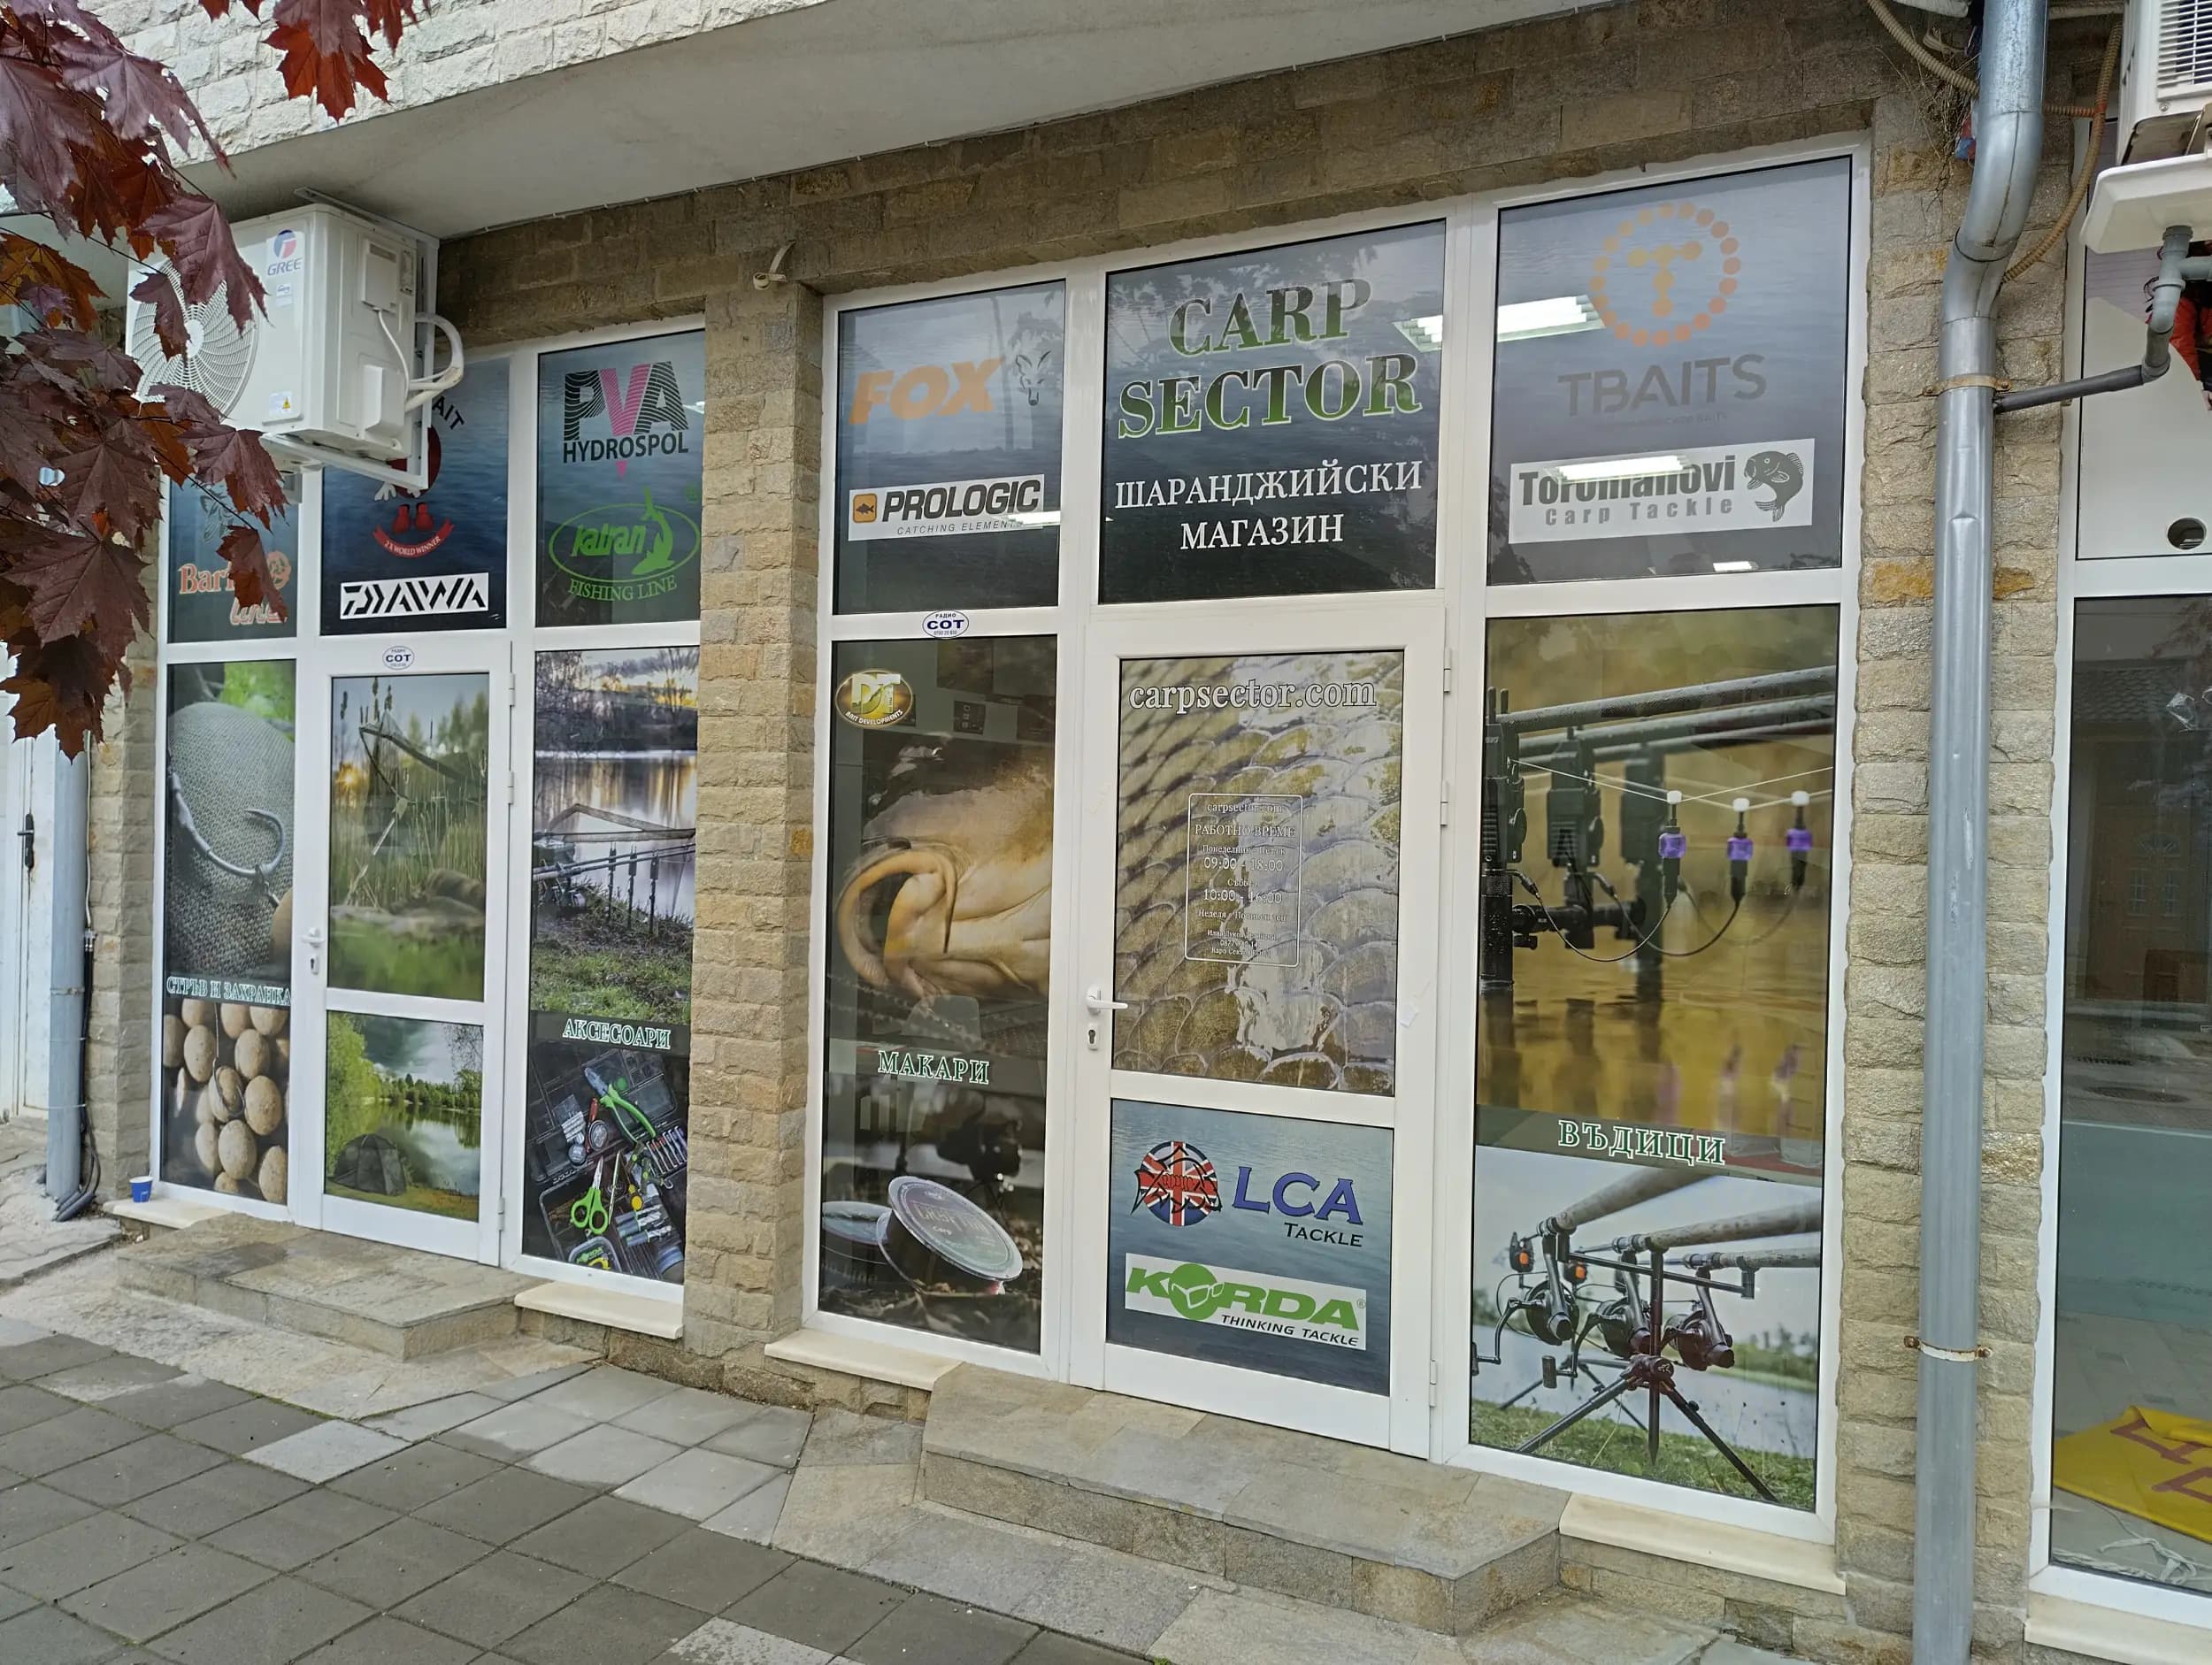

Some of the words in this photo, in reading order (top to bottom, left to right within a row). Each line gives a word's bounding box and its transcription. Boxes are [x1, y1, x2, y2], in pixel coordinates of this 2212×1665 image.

[267, 257, 303, 277] GREE
[1169, 278, 1371, 357] CARP
[564, 361, 689, 441] PVA
[849, 357, 1004, 425] FOX
[1118, 353, 1422, 439] SECTOR
[1557, 354, 1767, 417] TBAITS
[563, 432, 688, 464] HYDROSPOL
[1115, 458, 1423, 508] ШАРАНДЖИЙСКИ
[1519, 455, 1736, 505] Toromanovi
[882, 480, 1041, 522] PROLOGIC
[1546, 506, 1610, 526] Carp
[1630, 495, 1732, 521] Tackle
[415, 536, 442, 554] WINNER
[897, 523, 956, 535] CATCHING
[1180, 514, 1344, 549] МАГАЗИН
[342, 577, 487, 616] DAIWA
[569, 578, 634, 602] FISHING
[636, 574, 677, 600] LINE
[1129, 679, 1376, 715] carpsector.com
[846, 711, 859, 722] BAIT
[1194, 825, 1250, 837] РАБОТНО
[1254, 825, 1295, 838] ВРЕМЕ
[1203, 856, 1237, 870] 09:00
[1250, 858, 1283, 871] 18:00
[1203, 889, 1236, 902] 10:00
[166, 976, 208, 997] СТРЪВ
[210, 979, 221, 998] И
[563, 1018, 671, 1050] АКСЕСОАРИ
[878, 1050, 989, 1085] МАКАРИ
[1558, 1119, 1725, 1166] ВЪДИЦИ
[1232, 1166, 1363, 1225] LCA
[1285, 1223, 1363, 1247] TACKLE
[1125, 1262, 1360, 1331] KORDA
[1221, 1315, 1295, 1335] THINKING
[1302, 1328, 1359, 1347] TACKLE
